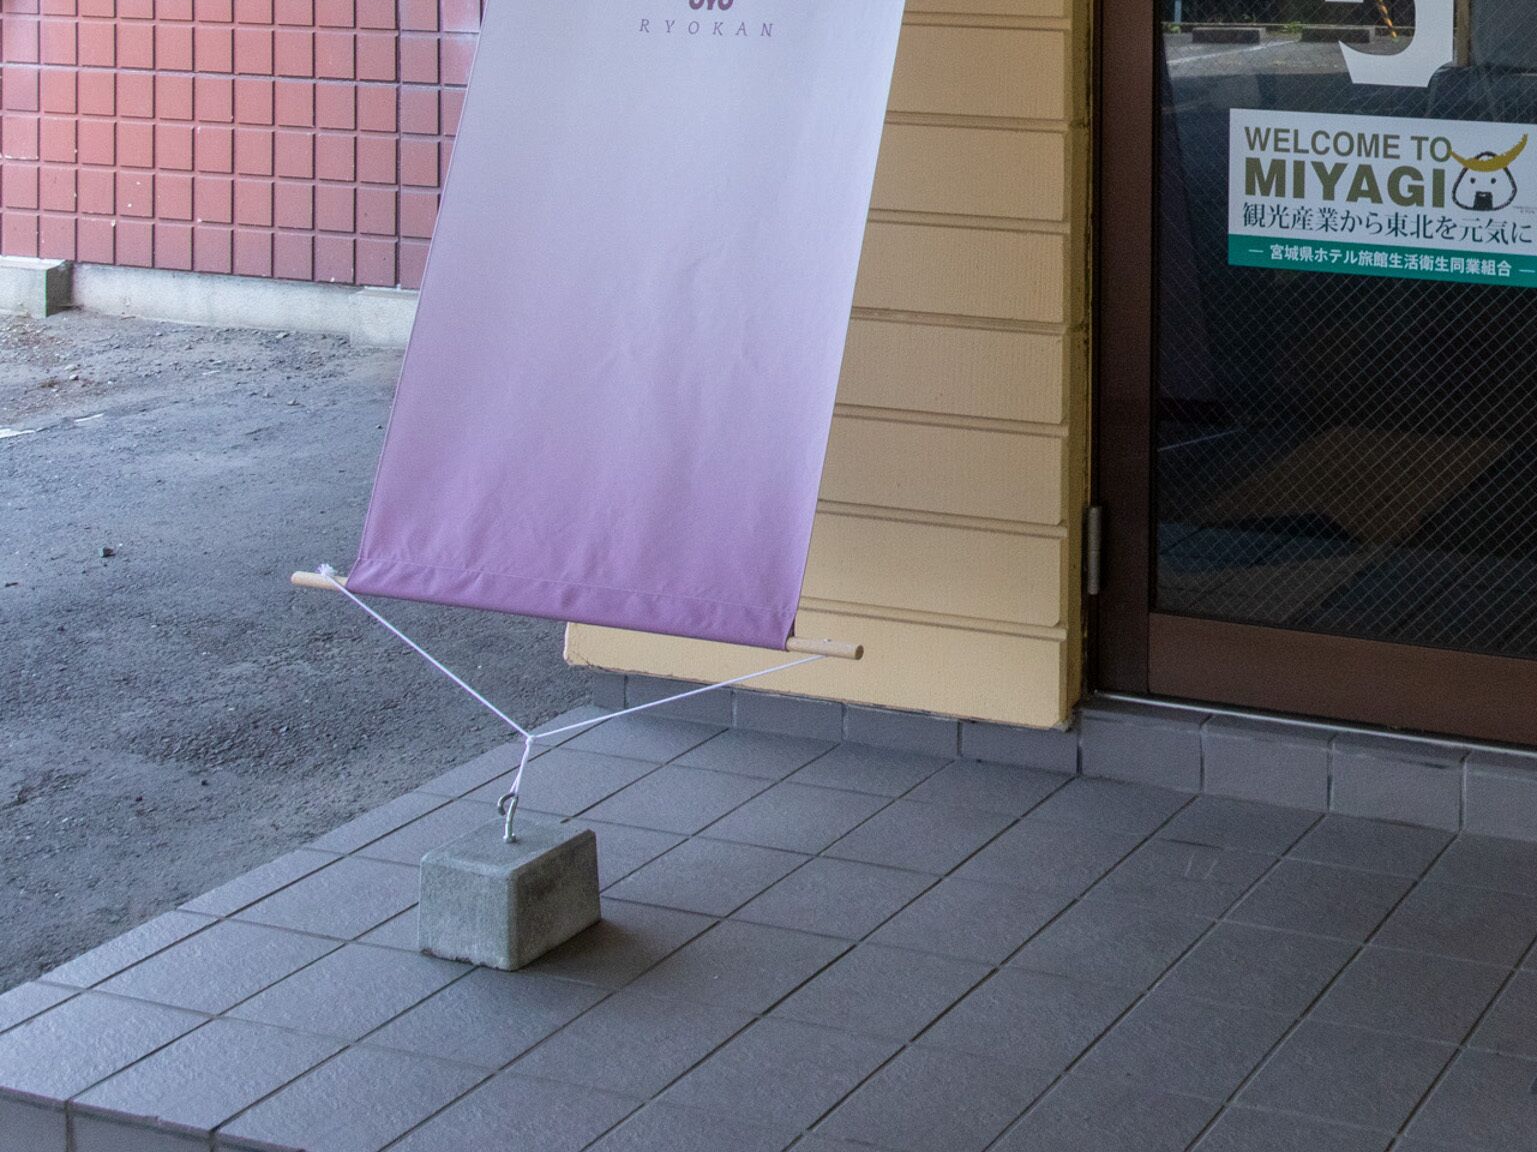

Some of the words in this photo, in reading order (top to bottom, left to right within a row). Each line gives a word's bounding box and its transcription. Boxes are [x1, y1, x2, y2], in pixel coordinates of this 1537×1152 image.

[639, 19, 774, 37] RYOKAN
[1244, 126, 1401, 160] WELCOME
[1410, 135, 1452, 163] TO
[1244, 157, 1446, 209] MIYAGI
